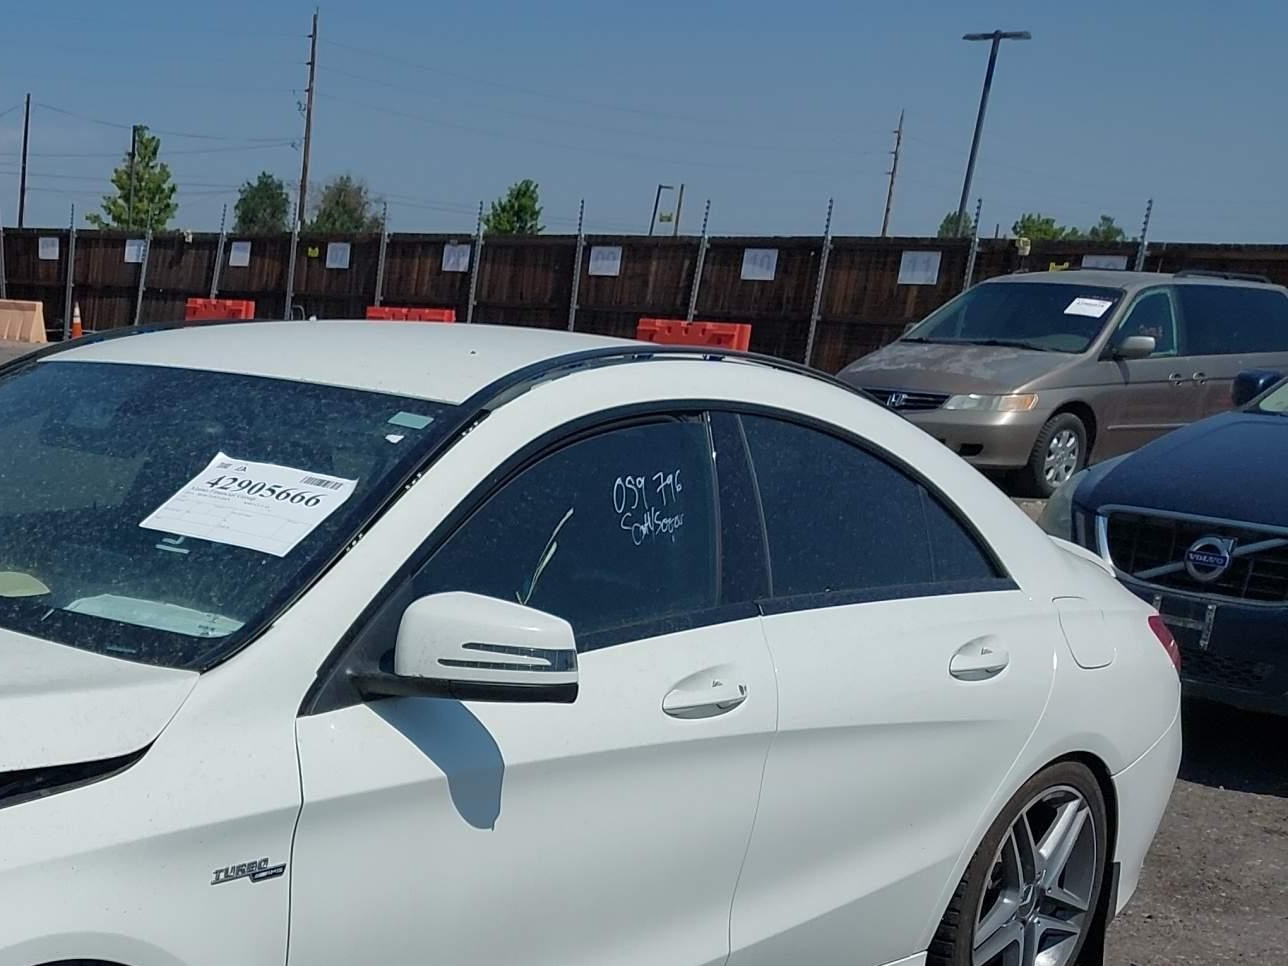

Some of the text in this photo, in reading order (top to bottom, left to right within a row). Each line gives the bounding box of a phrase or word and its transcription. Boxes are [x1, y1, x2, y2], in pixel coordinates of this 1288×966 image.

[206, 474, 322, 507] 42905666
[652, 469, 683, 506] 796
[1189, 552, 1225, 566] VOLVO
[212, 857, 269, 881] TURBO
